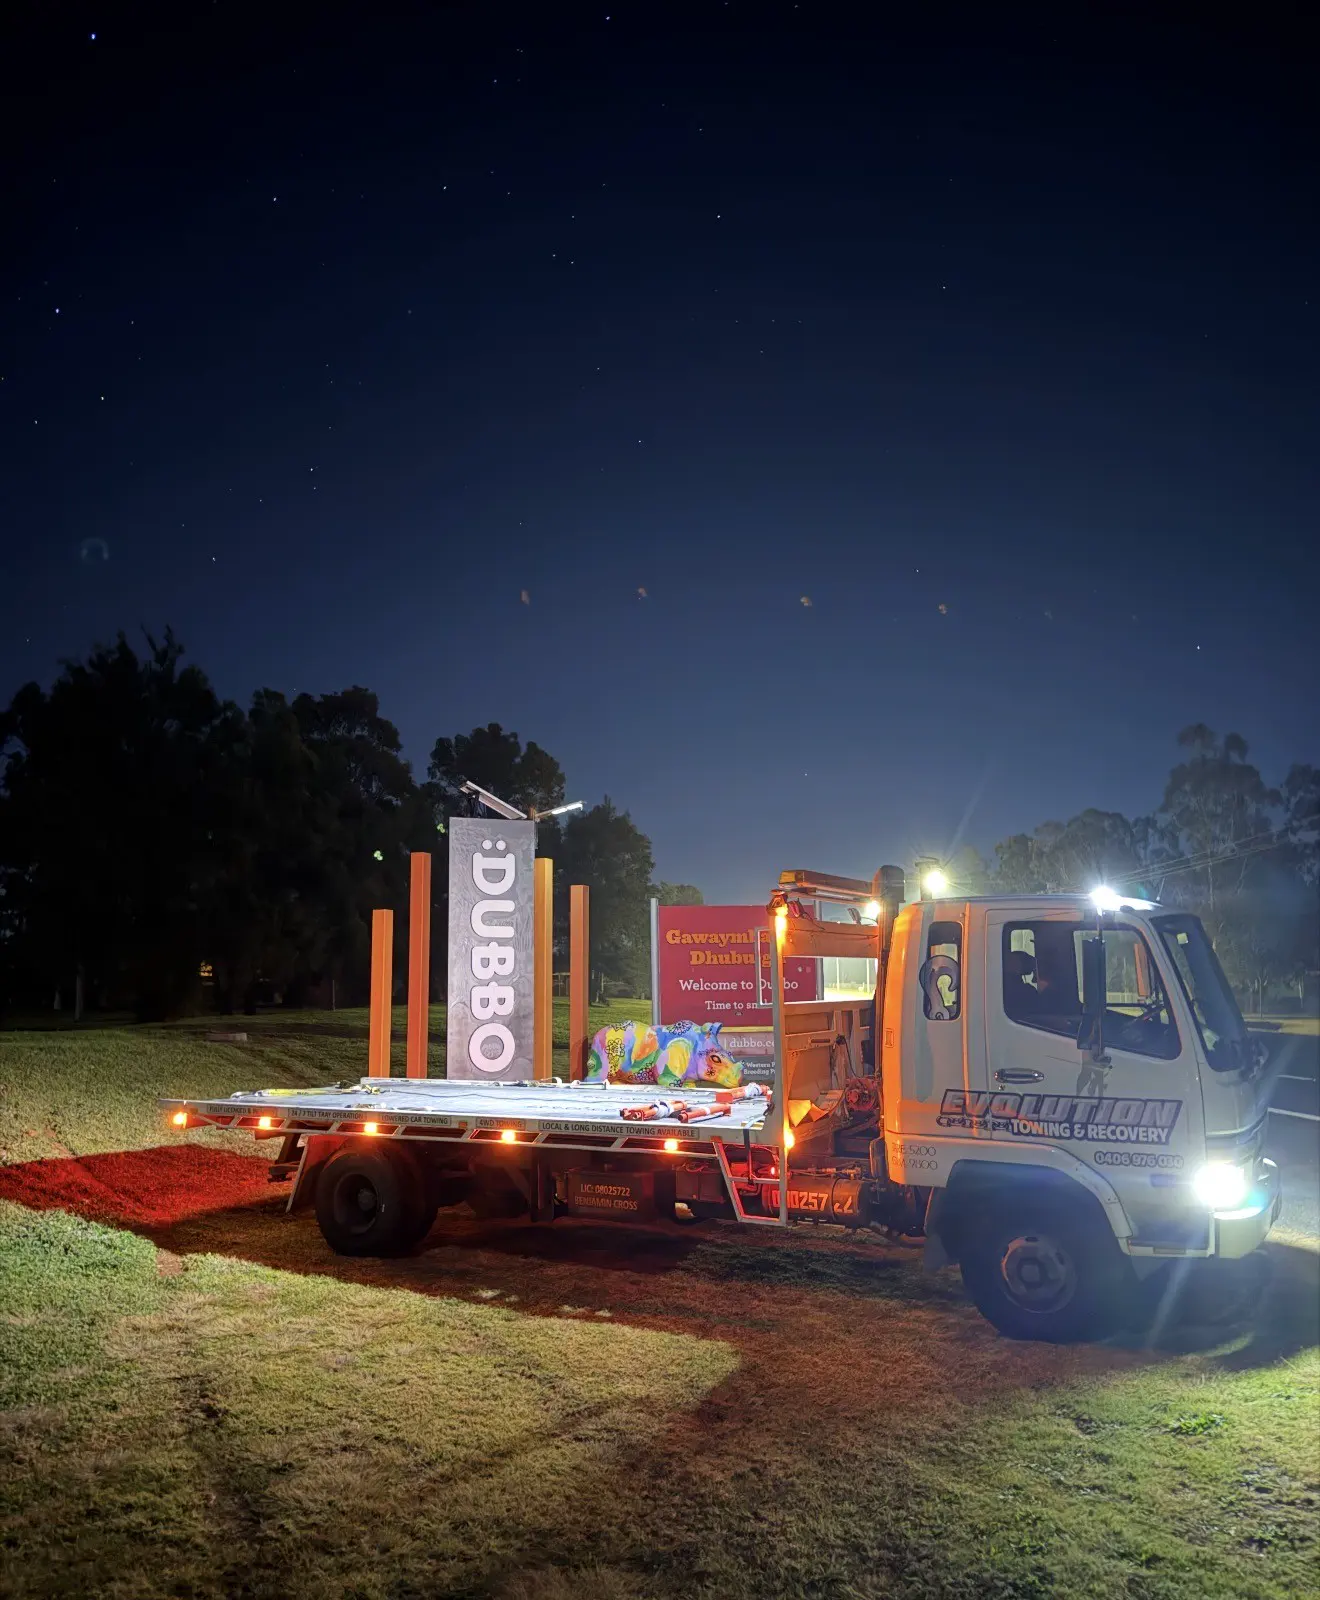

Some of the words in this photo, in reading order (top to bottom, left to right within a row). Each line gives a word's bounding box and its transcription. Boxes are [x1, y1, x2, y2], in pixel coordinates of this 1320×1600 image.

[679, 978, 738, 991] Welcome
[741, 979, 754, 990] to
[757, 978, 799, 991] Dubo
[704, 1000, 732, 1010] Time
[733, 1001, 744, 1010] to
[743, 1068, 770, 1076] Breeding
[941, 1090, 1183, 1126] EVOLUTION
[333, 1112, 364, 1120] OPERATION
[382, 1115, 409, 1123] LOWERED
[410, 1116, 423, 1124] CAR
[424, 1117, 448, 1125] TOWING
[592, 1125, 624, 1134] DISTANCE
[626, 1127, 655, 1135] TOWING
[656, 1128, 695, 1137] AVAILABLE
[1011, 1118, 1071, 1138] TOWING
[1073, 1126, 1085, 1139] &
[1087, 1124, 1170, 1143] RECOVERY
[1095, 1151, 1130, 1165] 0406
[1132, 1153, 1156, 1167] 976
[595, 1184, 631, 1197] 08025722
[613, 1199, 638, 1211] CROSS
